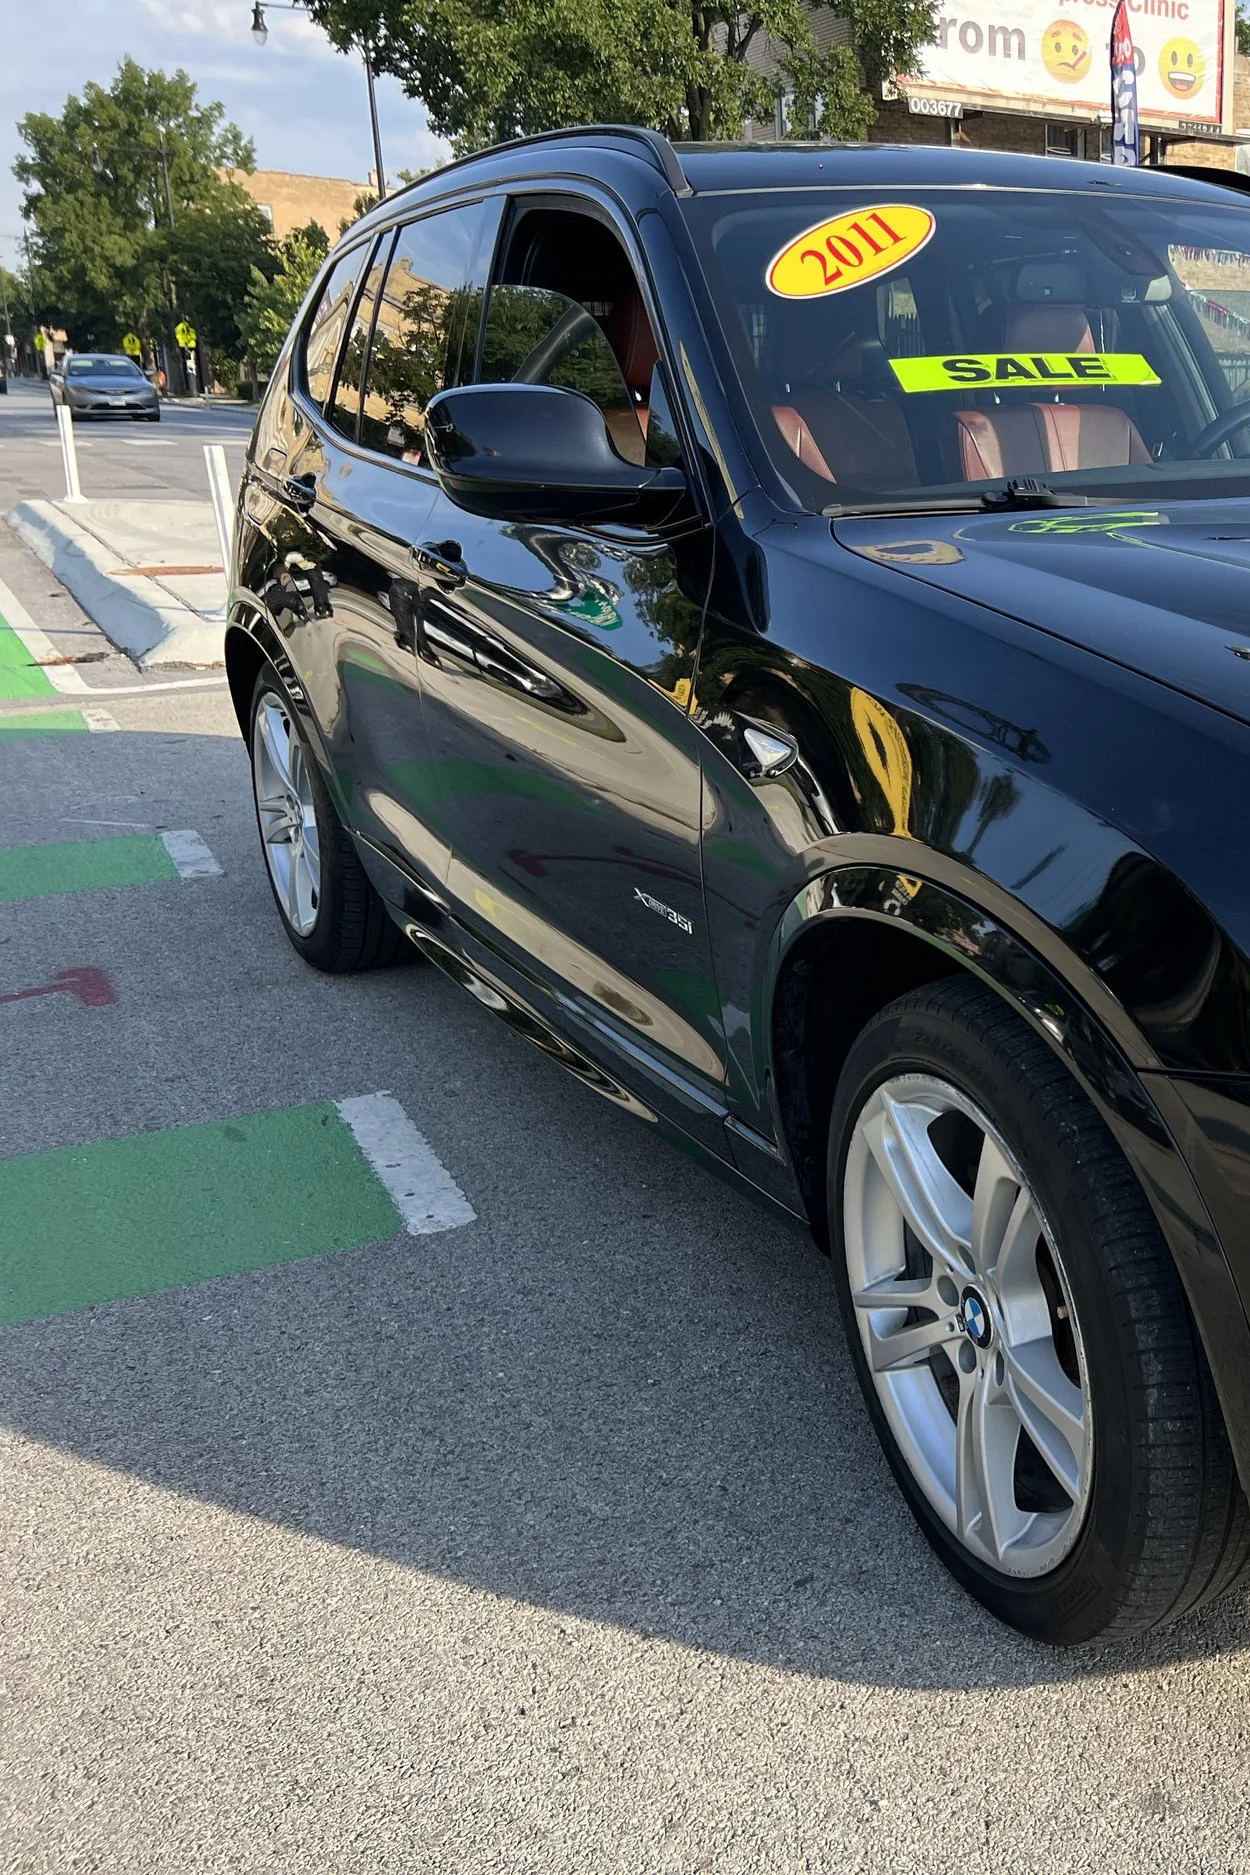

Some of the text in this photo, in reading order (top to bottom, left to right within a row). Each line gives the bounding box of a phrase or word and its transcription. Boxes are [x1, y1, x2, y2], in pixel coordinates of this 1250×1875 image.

[939, 16, 1026, 61] rom
[911, 98, 962, 117] 003677
[800, 212, 908, 286] 2011
[942, 355, 1114, 384] SALE
